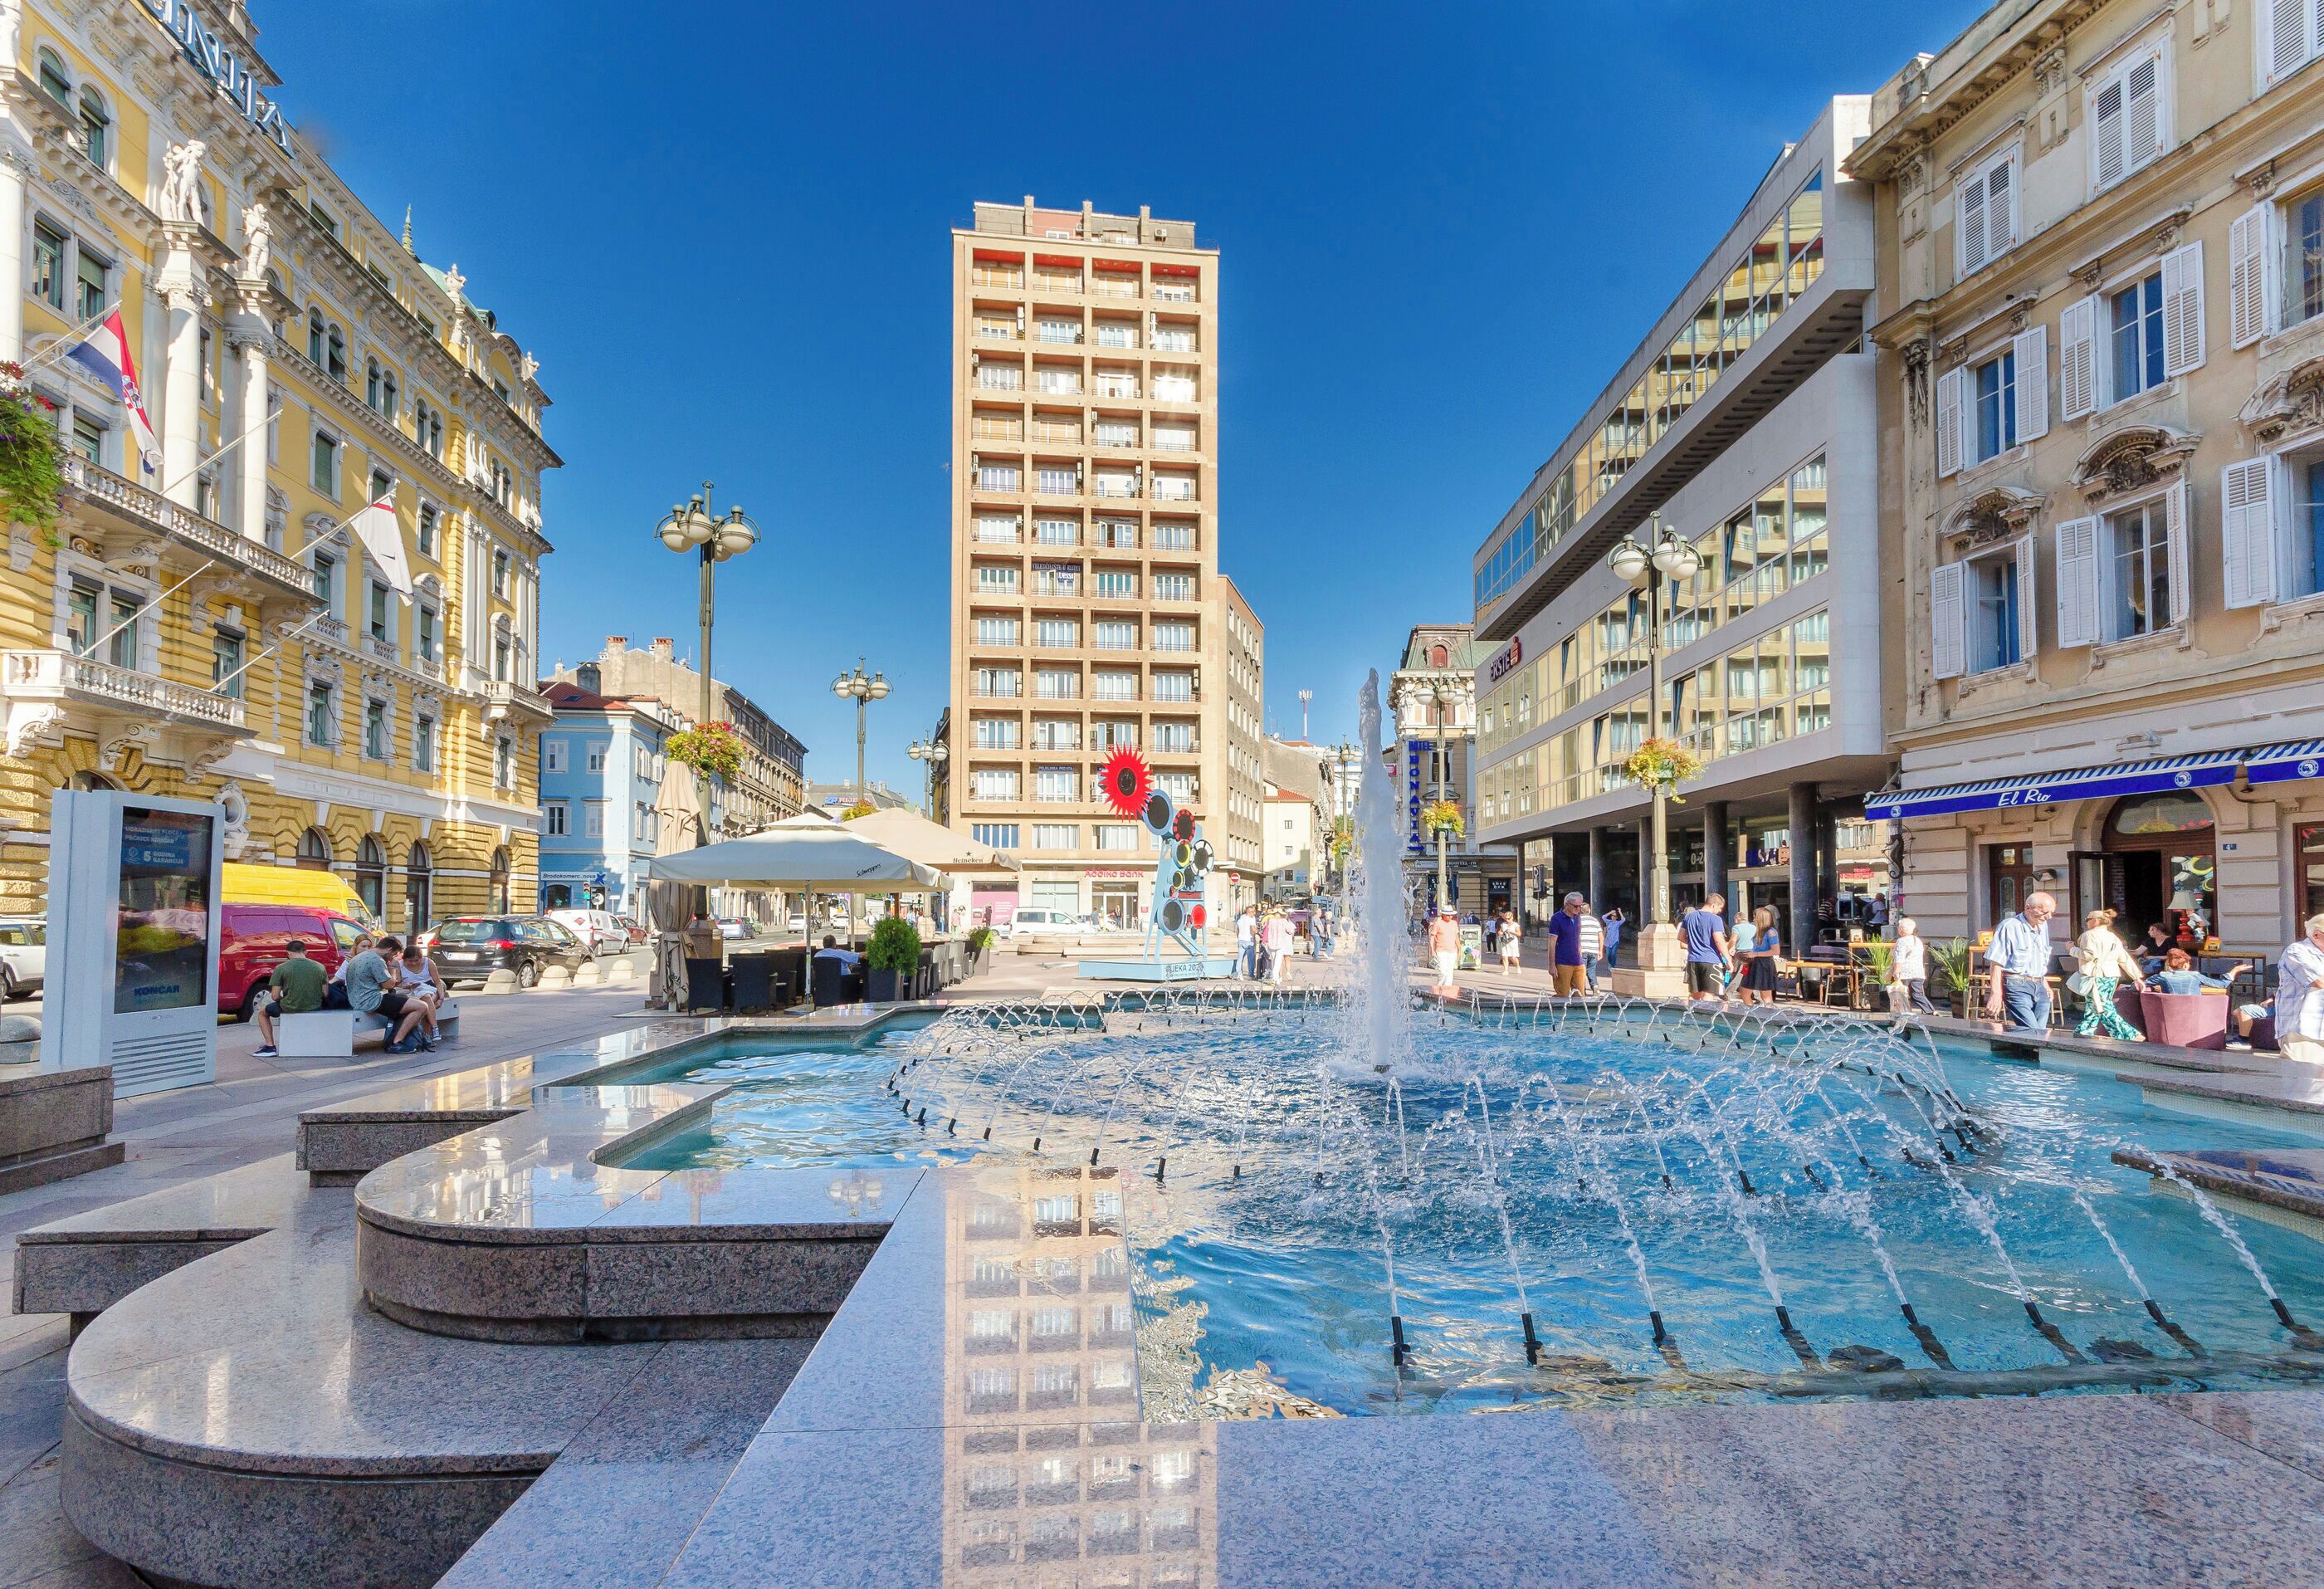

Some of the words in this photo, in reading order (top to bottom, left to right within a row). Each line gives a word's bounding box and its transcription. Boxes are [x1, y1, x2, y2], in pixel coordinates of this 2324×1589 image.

[1409, 741, 1430, 751] HOTEL
[1409, 755, 1420, 843] BONAVIA
[1998, 790, 2019, 806] El
[2024, 789, 2052, 804] Rio
[1691, 852, 1706, 865] 0-2
[856, 863, 881, 878] Schweppes
[1084, 868, 1117, 878] Addiko
[1120, 868, 1144, 878] Bank
